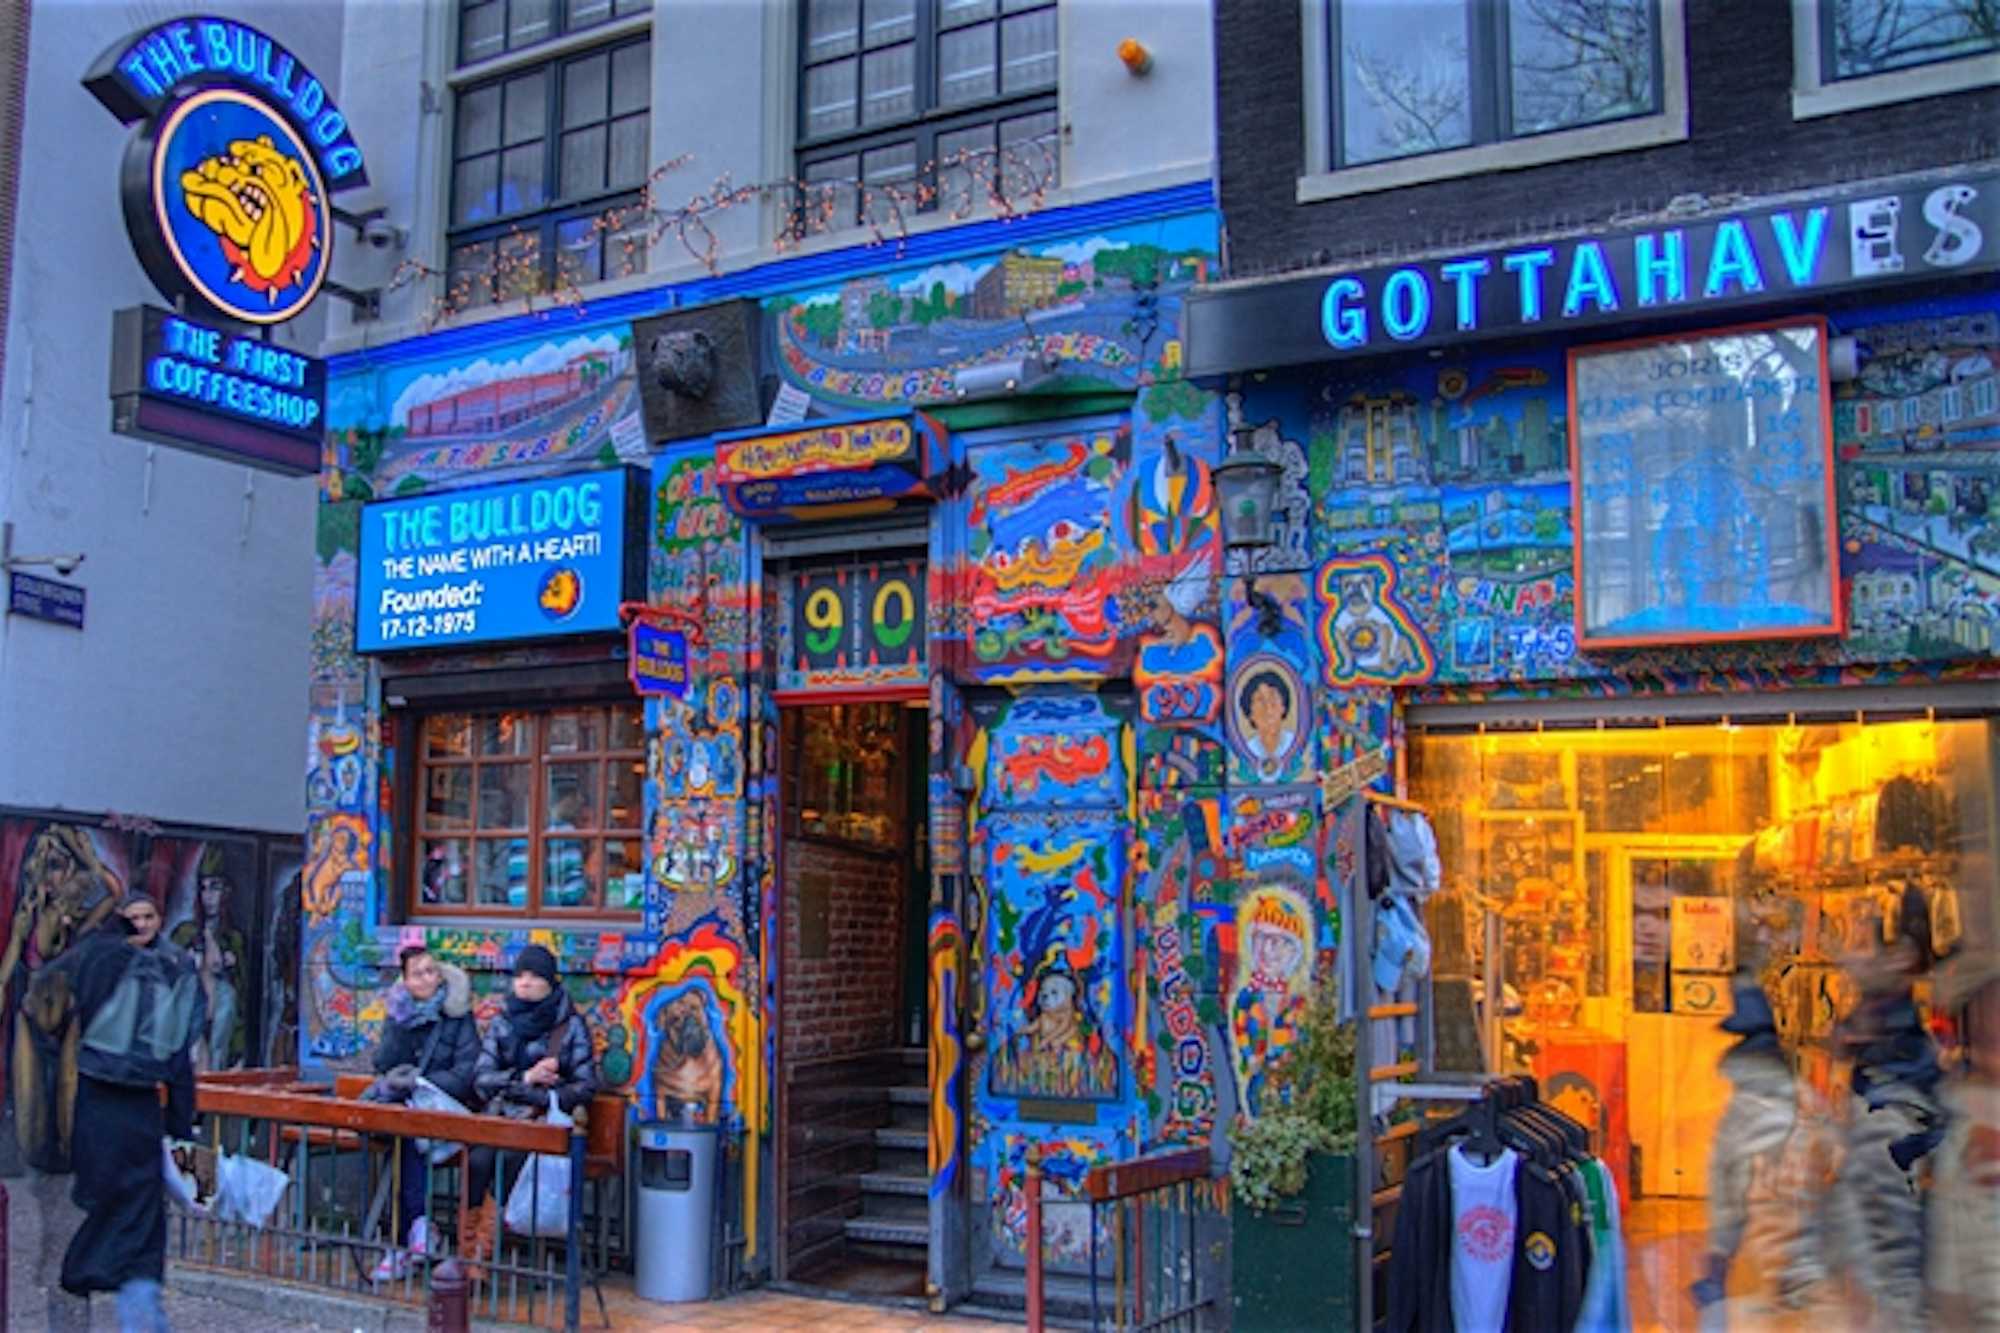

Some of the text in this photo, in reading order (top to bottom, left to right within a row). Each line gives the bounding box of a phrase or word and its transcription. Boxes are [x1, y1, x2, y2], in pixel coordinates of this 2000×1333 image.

[127, 23, 362, 179] THE BULLDOG
[1320, 184, 1984, 350] GOTTAHAVES
[170, 320, 309, 386] THE FIRST
[154, 358, 321, 426] COFFEESHOP
[382, 482, 600, 551] THE BULLDOG
[382, 556, 414, 580] THE
[418, 548, 467, 577] NAME
[470, 543, 514, 570] WITH
[518, 543, 533, 563] A
[379, 579, 484, 615] Founded:
[380, 610, 476, 640] 17-12-1975
